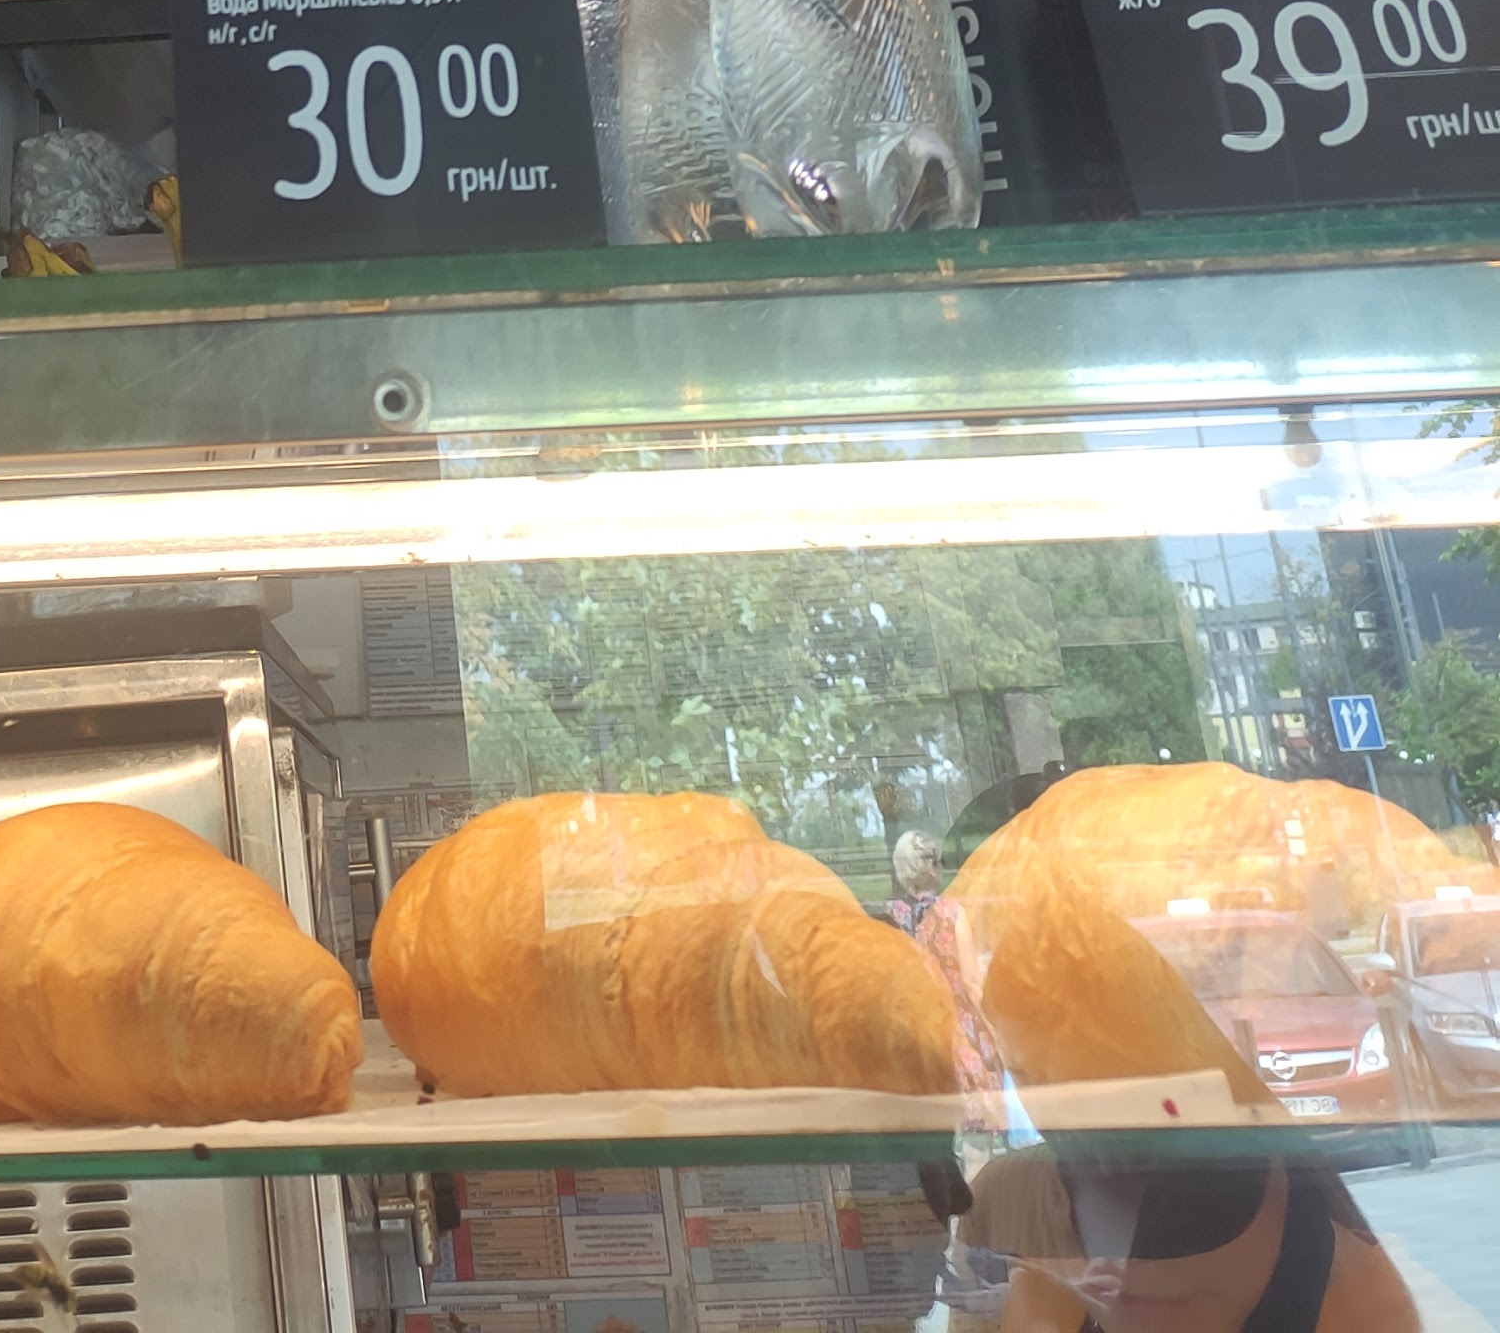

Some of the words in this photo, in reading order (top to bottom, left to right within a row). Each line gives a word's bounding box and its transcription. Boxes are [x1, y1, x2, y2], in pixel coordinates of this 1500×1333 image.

[267, 44, 424, 201] 30
[437, 42, 520, 119] 00
[1186, 0, 1369, 153] 39
[446, 158, 558, 203] грн/шт.
